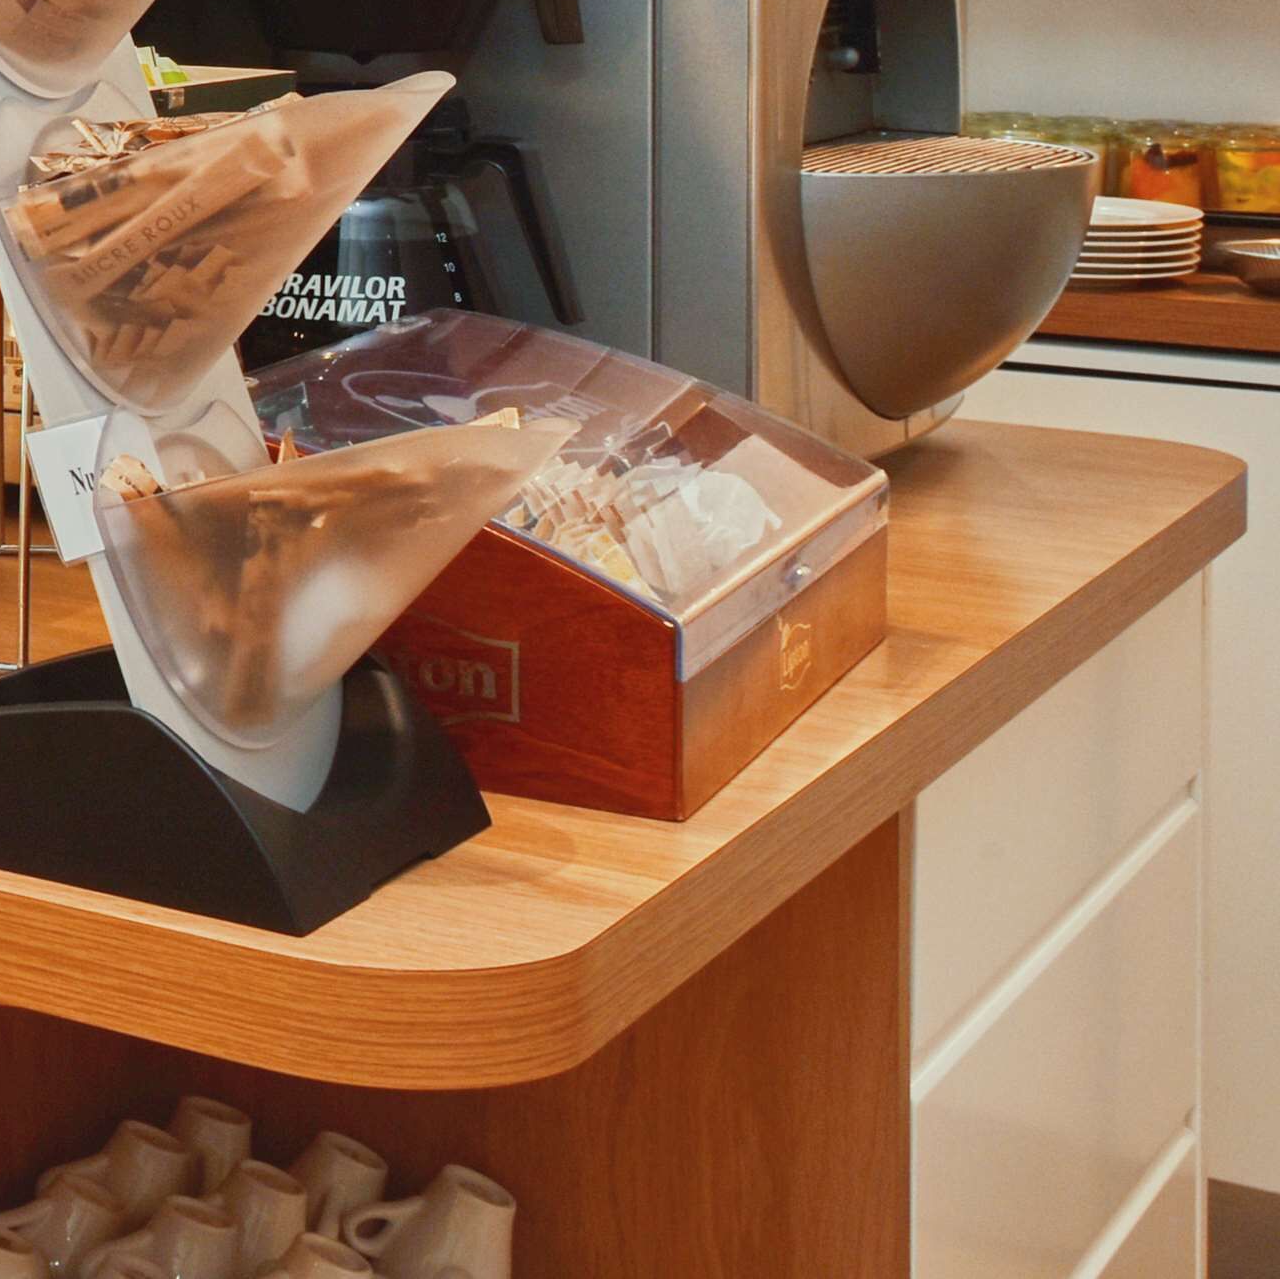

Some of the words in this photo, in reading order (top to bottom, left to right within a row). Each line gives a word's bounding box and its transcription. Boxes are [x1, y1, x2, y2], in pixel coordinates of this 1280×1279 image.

[142, 197, 201, 242] ROUX
[436, 232, 448, 243] 12
[443, 262, 456, 272] 10
[276, 273, 406, 300] RAVILOR
[258, 295, 406, 323] BONAMAT
